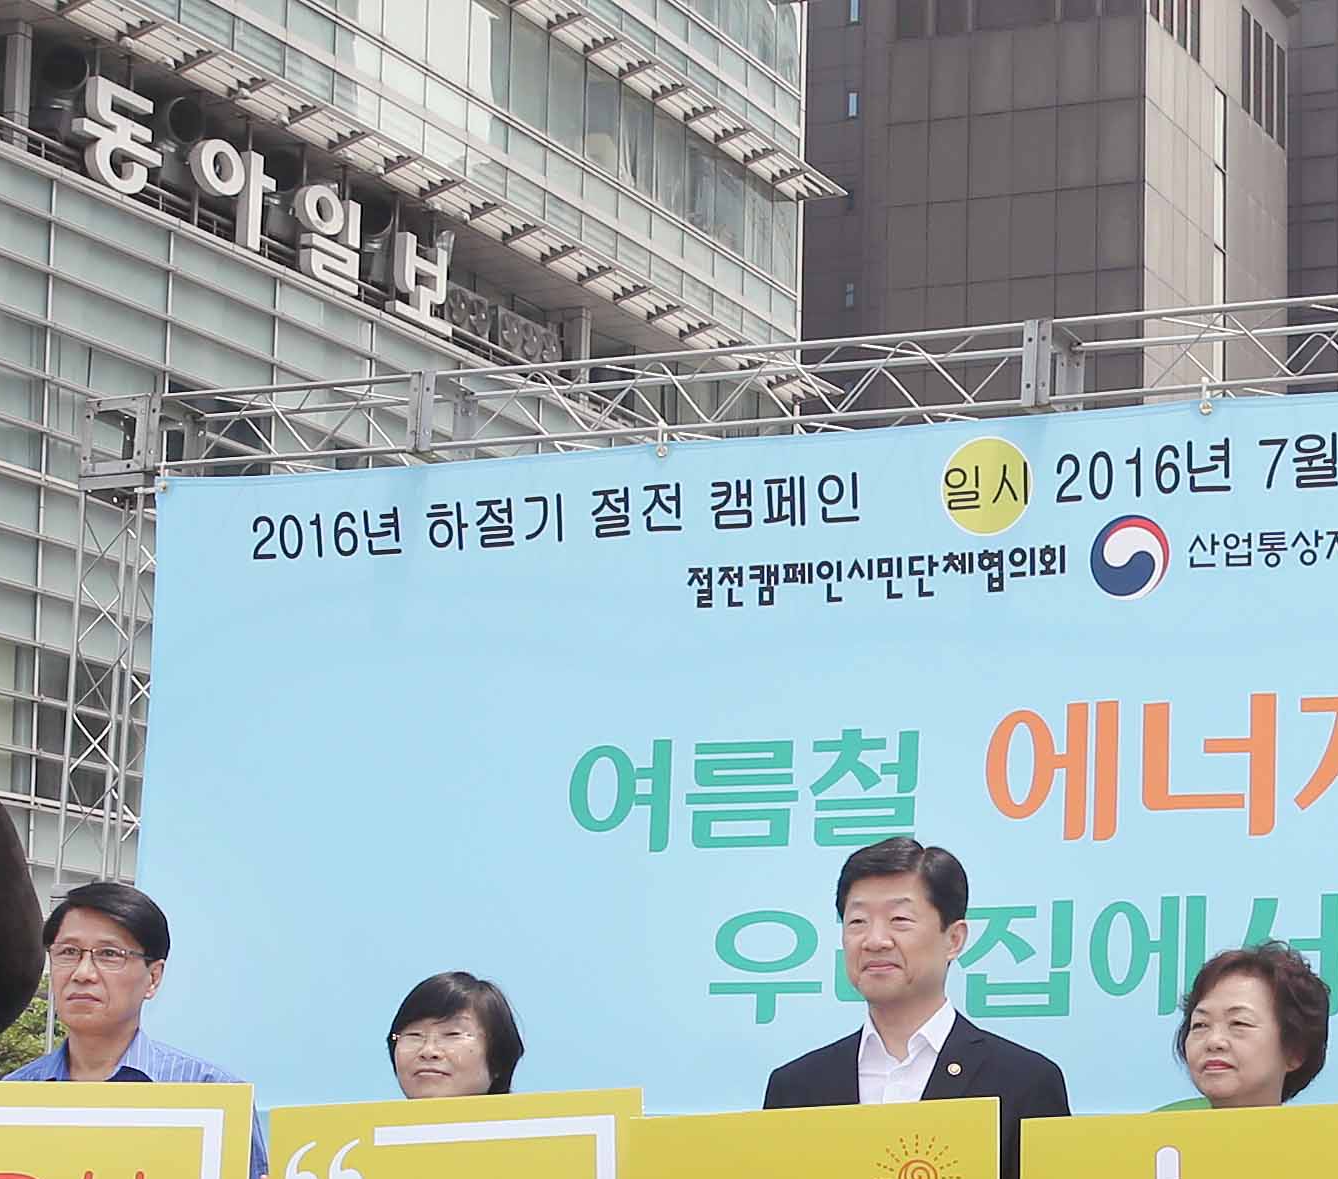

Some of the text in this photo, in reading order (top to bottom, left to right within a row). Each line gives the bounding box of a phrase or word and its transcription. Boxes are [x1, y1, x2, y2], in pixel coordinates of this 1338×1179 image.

[72, 76, 453, 338] 동아일보
[944, 459, 1030, 513] 일시
[1055, 436, 1232, 504] 2016년
[1258, 431, 1338, 489] 7월
[251, 471, 861, 561] 2016년 하절기 절전 캠페인
[686, 545, 1067, 609] 절전캠페인시민단체협의회
[568, 727, 921, 855] 여름철
